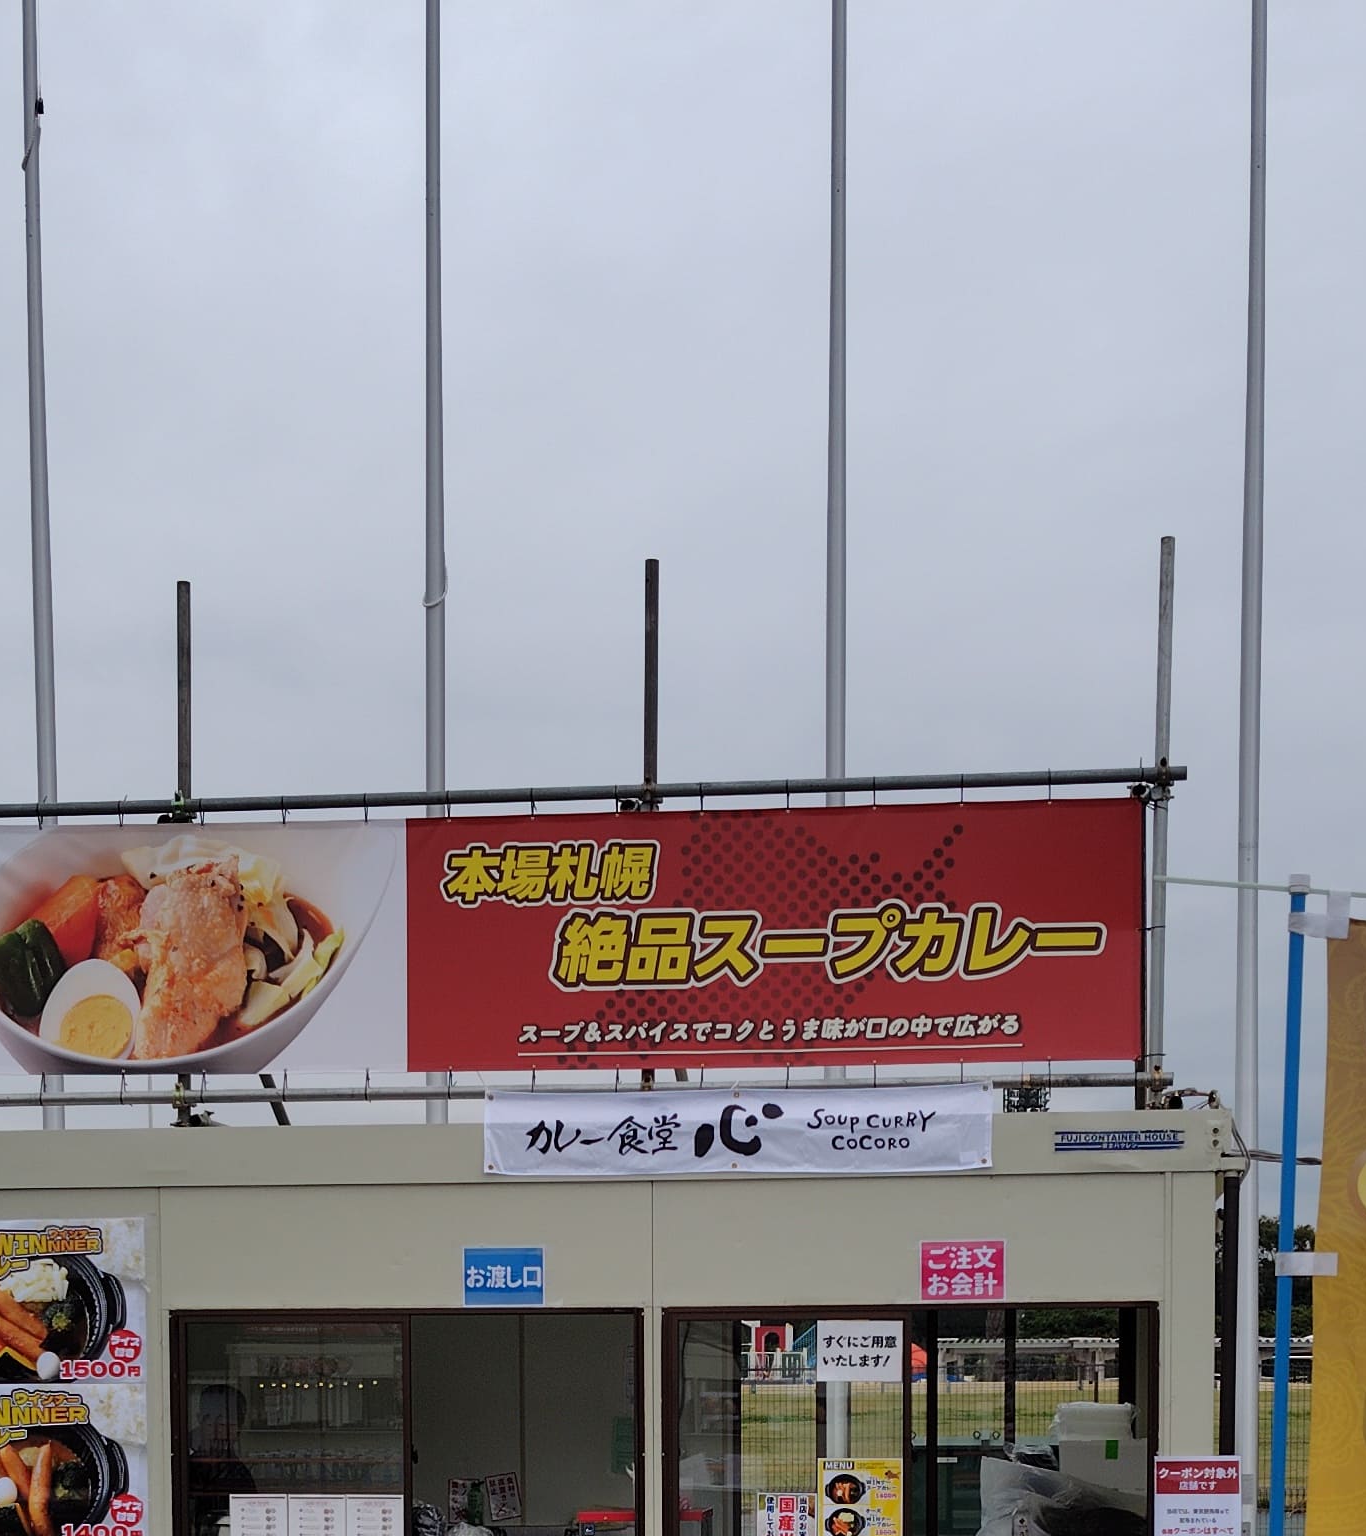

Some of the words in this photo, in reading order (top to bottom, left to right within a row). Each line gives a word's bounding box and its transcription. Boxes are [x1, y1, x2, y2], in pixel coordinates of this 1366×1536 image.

[445, 842, 655, 904] 本場札幌
[557, 903, 1105, 987] 絶品スープカレー
[866, 1109, 936, 1133] CURRY
[526, 1112, 683, 1155] カレー食堂
[1061, 1134, 1082, 1143] FUJI
[1084, 1132, 1141, 1142] CONTAINER
[1144, 1131, 1179, 1141] HOUSE
[928, 1246, 998, 1270] ご注文
[466, 1264, 543, 1290] お渡し口
[927, 1273, 998, 1297] お会計
[822, 1335, 898, 1351] すぐにご用意
[60, 1360, 142, 1378] 1500円
[825, 1462, 853, 1470] MENU
[1158, 1467, 1238, 1479] クーポン対象外
[1178, 1482, 1218, 1491] 店舗です
